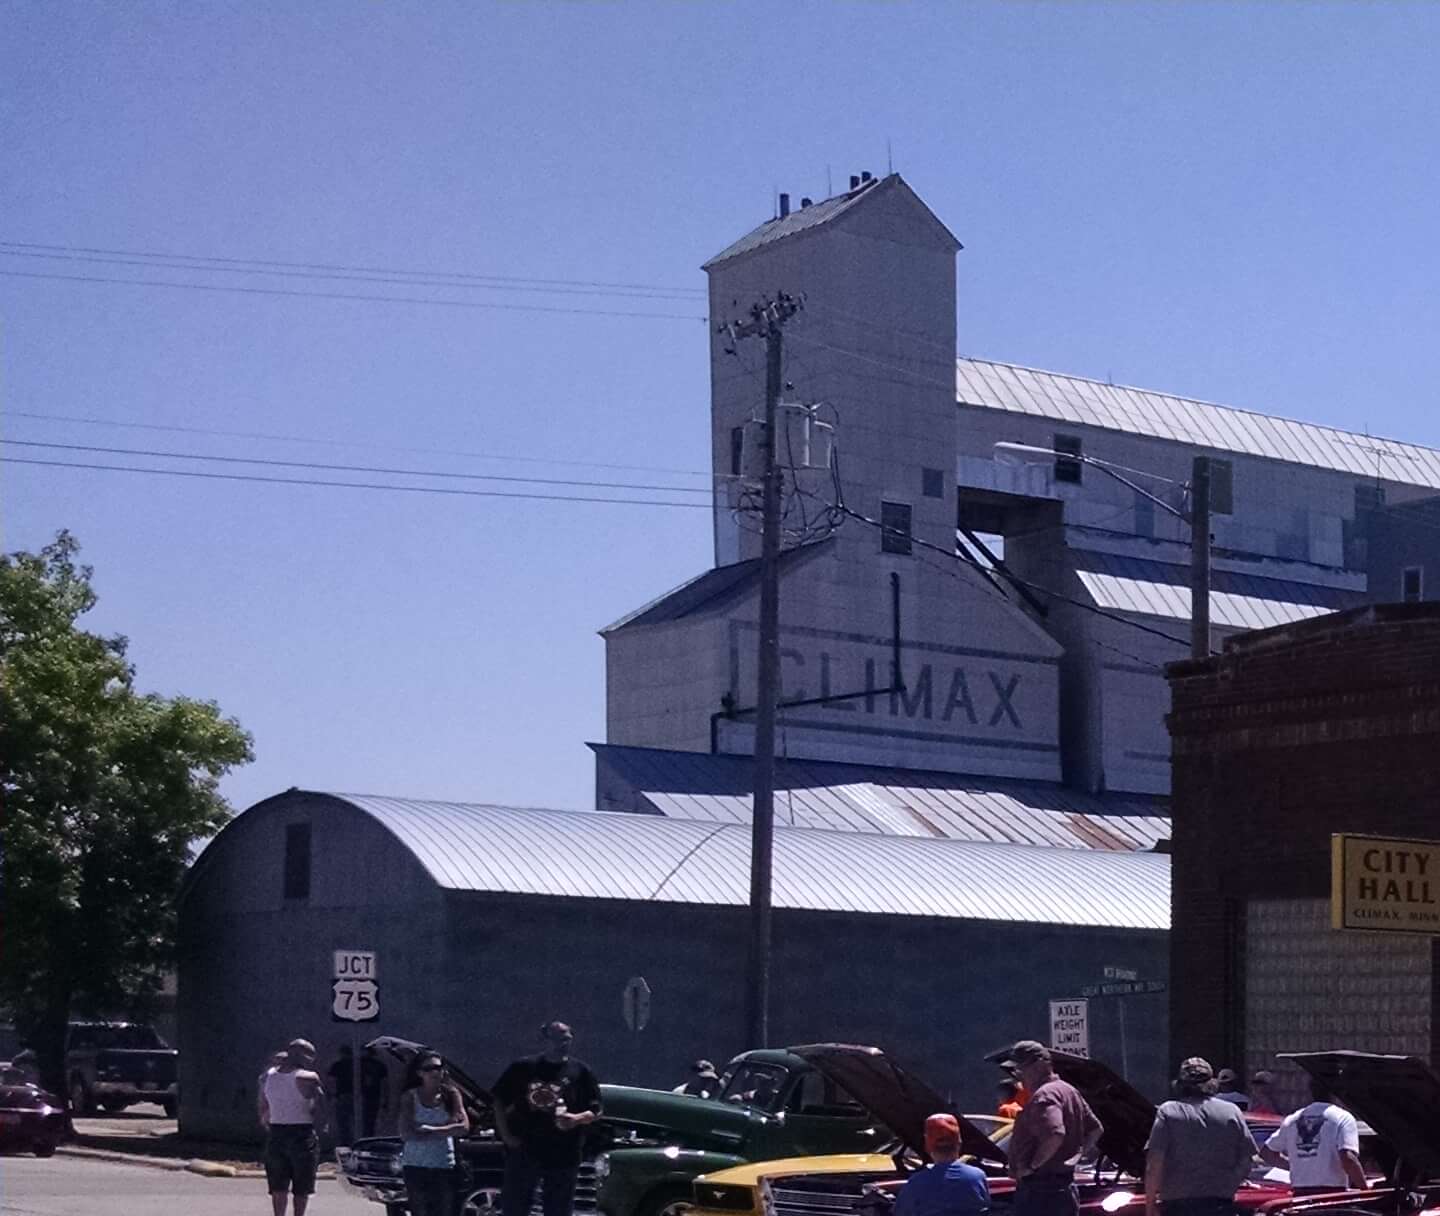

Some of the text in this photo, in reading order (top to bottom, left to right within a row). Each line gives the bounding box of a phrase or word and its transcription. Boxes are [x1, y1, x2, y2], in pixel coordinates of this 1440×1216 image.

[779, 647, 1022, 729] CLIMAX
[1363, 849, 1430, 875] CITY
[1359, 878, 1436, 904] HALL
[339, 956, 372, 974] JCT
[339, 991, 372, 1011] 75
[1057, 1005, 1081, 1016] AXLE
[1054, 1019, 1085, 1030] WEIGHT
[1058, 1032, 1081, 1044] LIMIT
